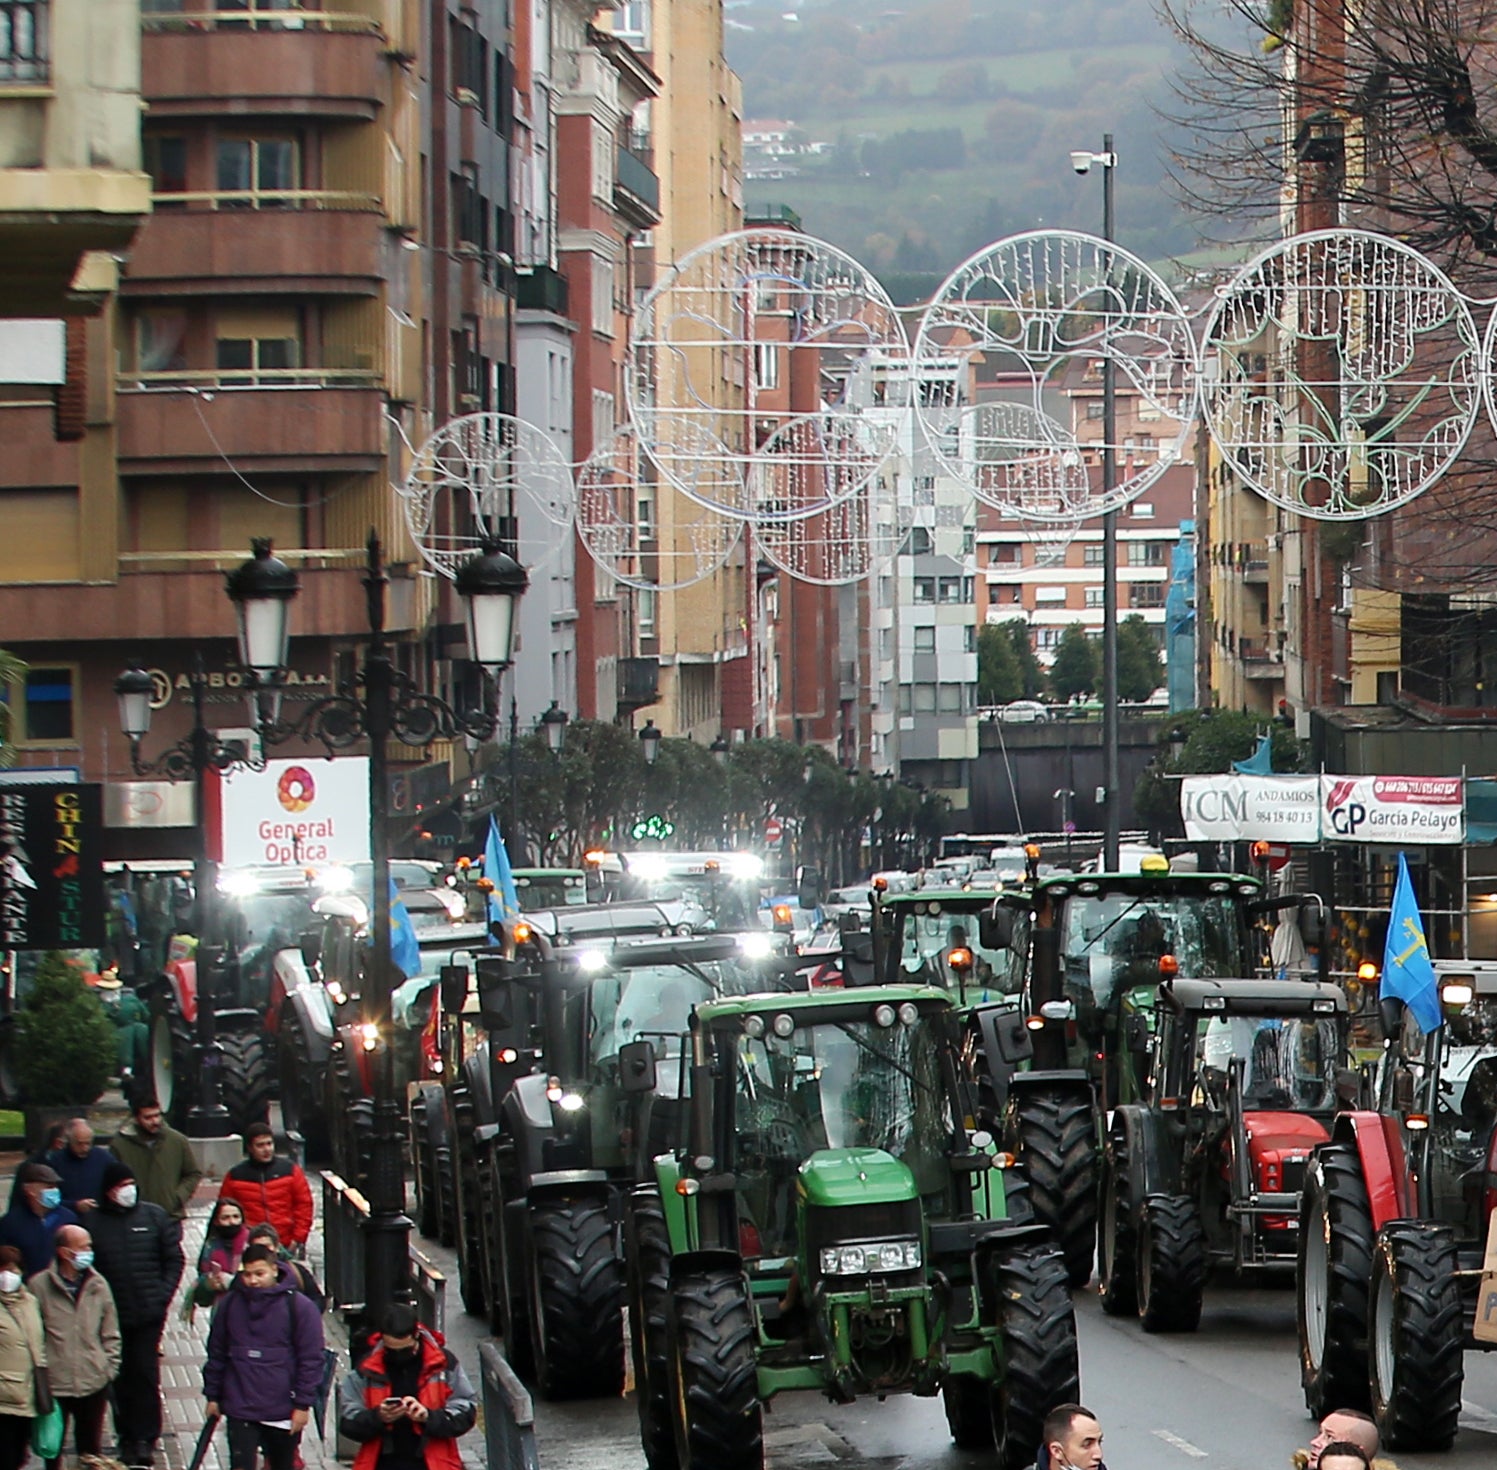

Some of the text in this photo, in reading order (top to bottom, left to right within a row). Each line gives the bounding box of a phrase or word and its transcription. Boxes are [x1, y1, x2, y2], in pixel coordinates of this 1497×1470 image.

[1185, 790, 1315, 823] ICM ANDAMIOS
[1274, 811, 1284, 823] 18
[1287, 811, 1298, 823] 40
[1301, 811, 1313, 823] 13
[259, 818, 334, 840] General
[1331, 803, 1366, 836] GP
[1369, 809, 1457, 832] García Pelayo
